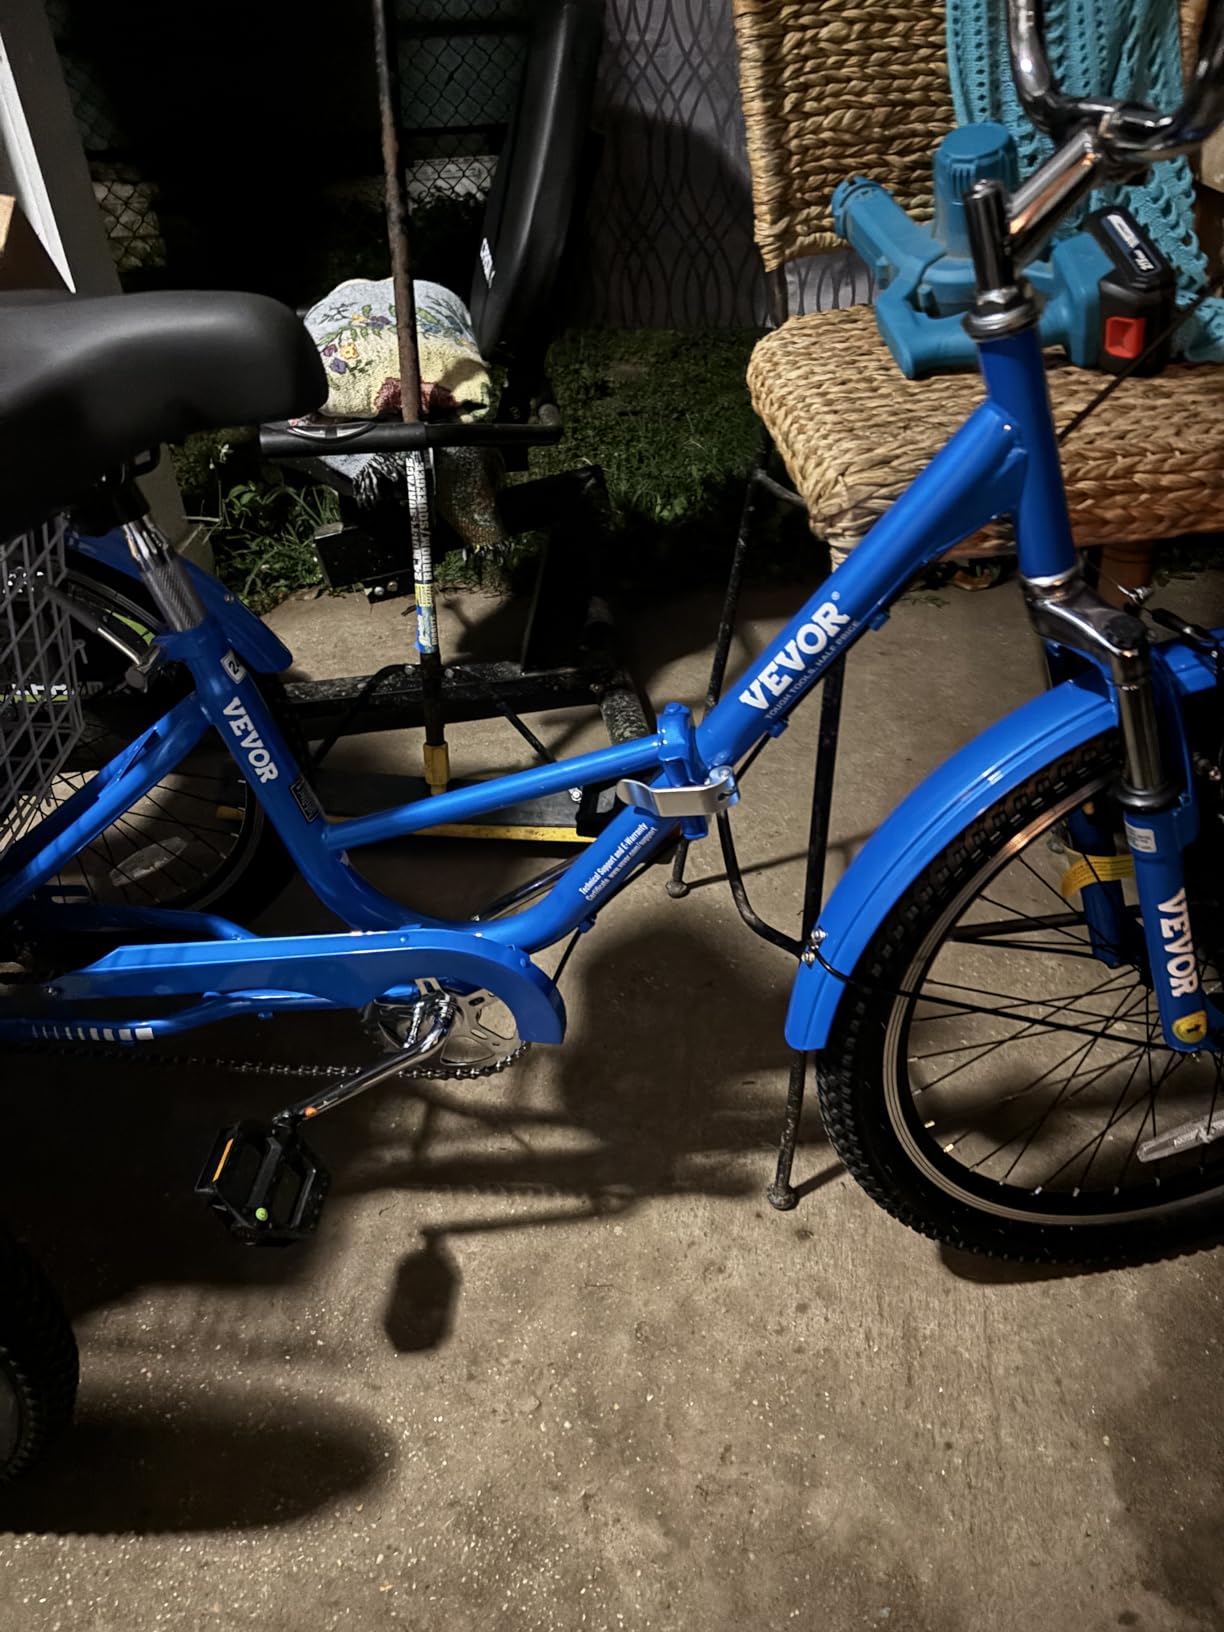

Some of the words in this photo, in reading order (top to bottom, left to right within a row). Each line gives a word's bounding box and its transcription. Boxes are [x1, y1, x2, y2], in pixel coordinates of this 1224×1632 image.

[414, 462, 432, 581] BROOM/SQUEEGEE
[765, 693, 791, 720] TOUGH
[815, 645, 837, 667] HALF
[836, 620, 860, 645] PRICE
[223, 697, 278, 783] VEVOR
[578, 872, 601, 895] Technical
[596, 855, 617, 875] Support
[612, 846, 625, 859] and
[619, 822, 648, 849] E-Warranty
[1157, 887, 1198, 998] VEVOR
